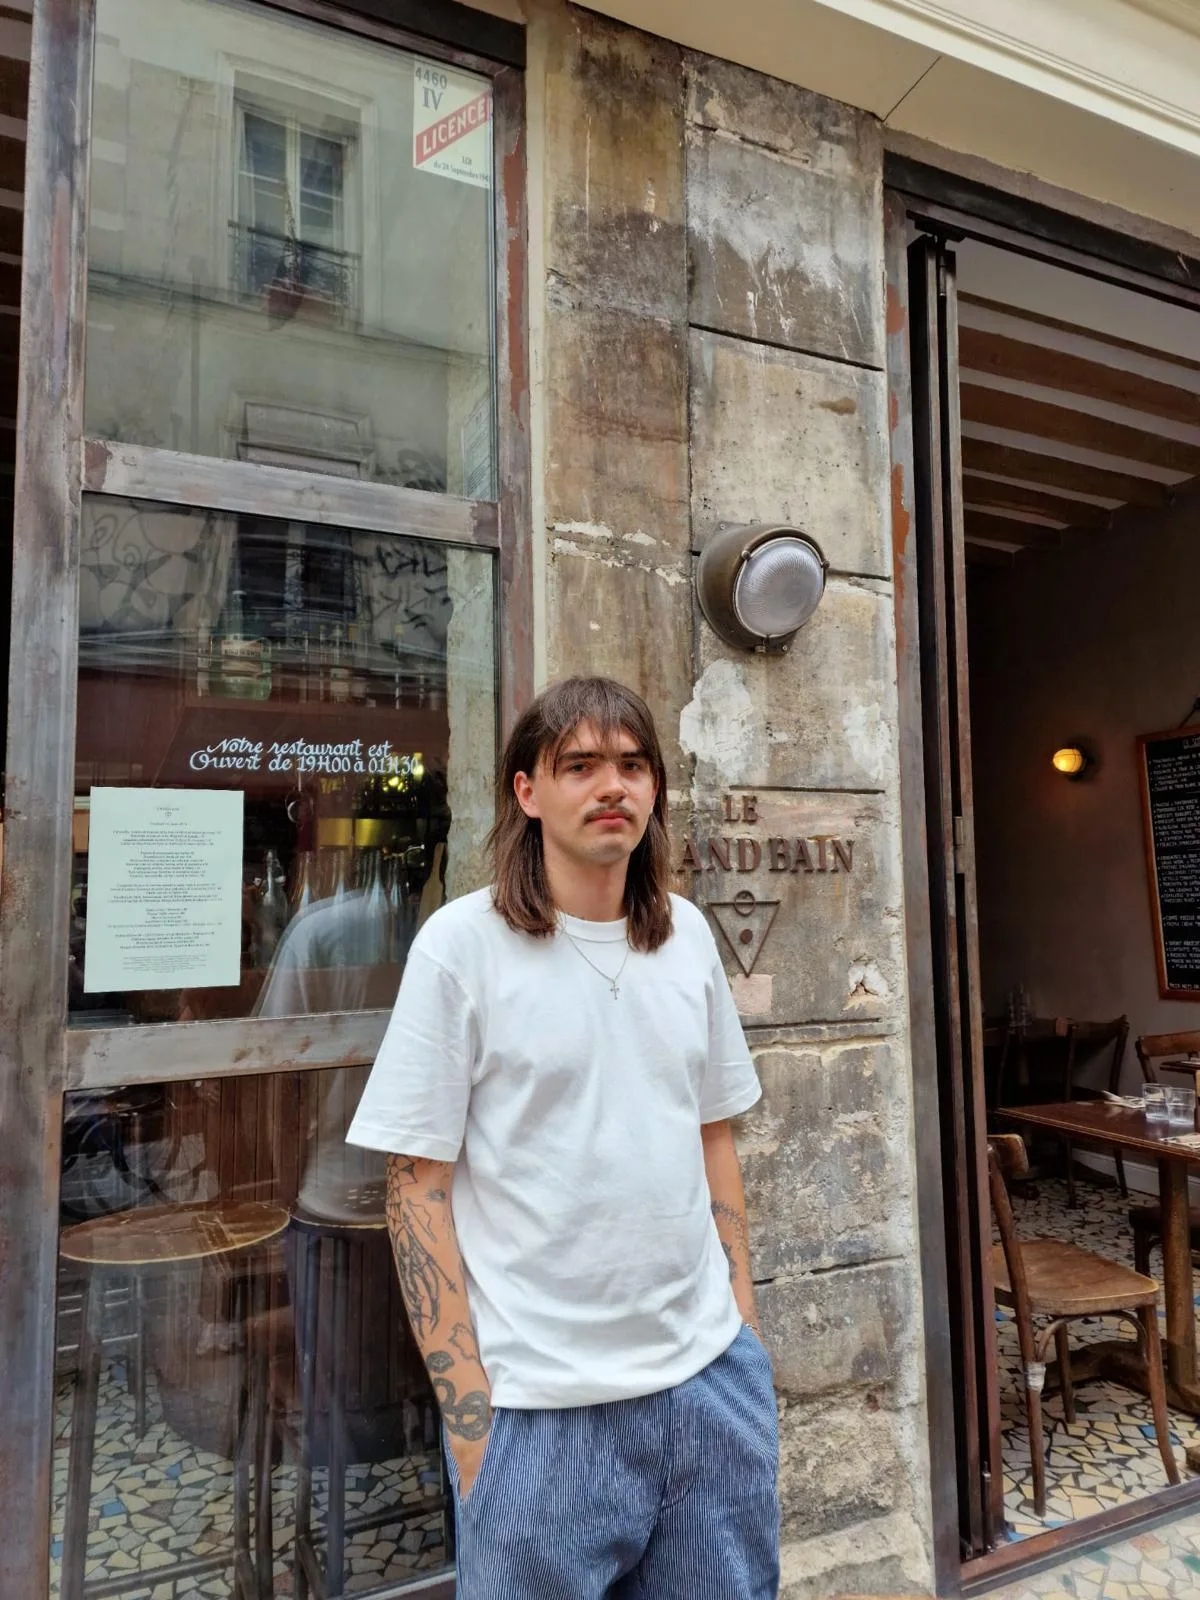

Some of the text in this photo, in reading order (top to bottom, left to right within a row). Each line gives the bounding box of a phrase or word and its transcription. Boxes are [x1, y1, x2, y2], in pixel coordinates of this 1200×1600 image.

[415, 67, 448, 90] 4460
[422, 86, 444, 111] IV
[422, 97, 486, 156] LICENCE
[206, 737, 393, 758] Notre restaurant est
[189, 750, 420, 775] Ouvert de 19H00 à 01H30
[723, 794, 759, 823] LE
[676, 835, 856, 874] AND BAIN
